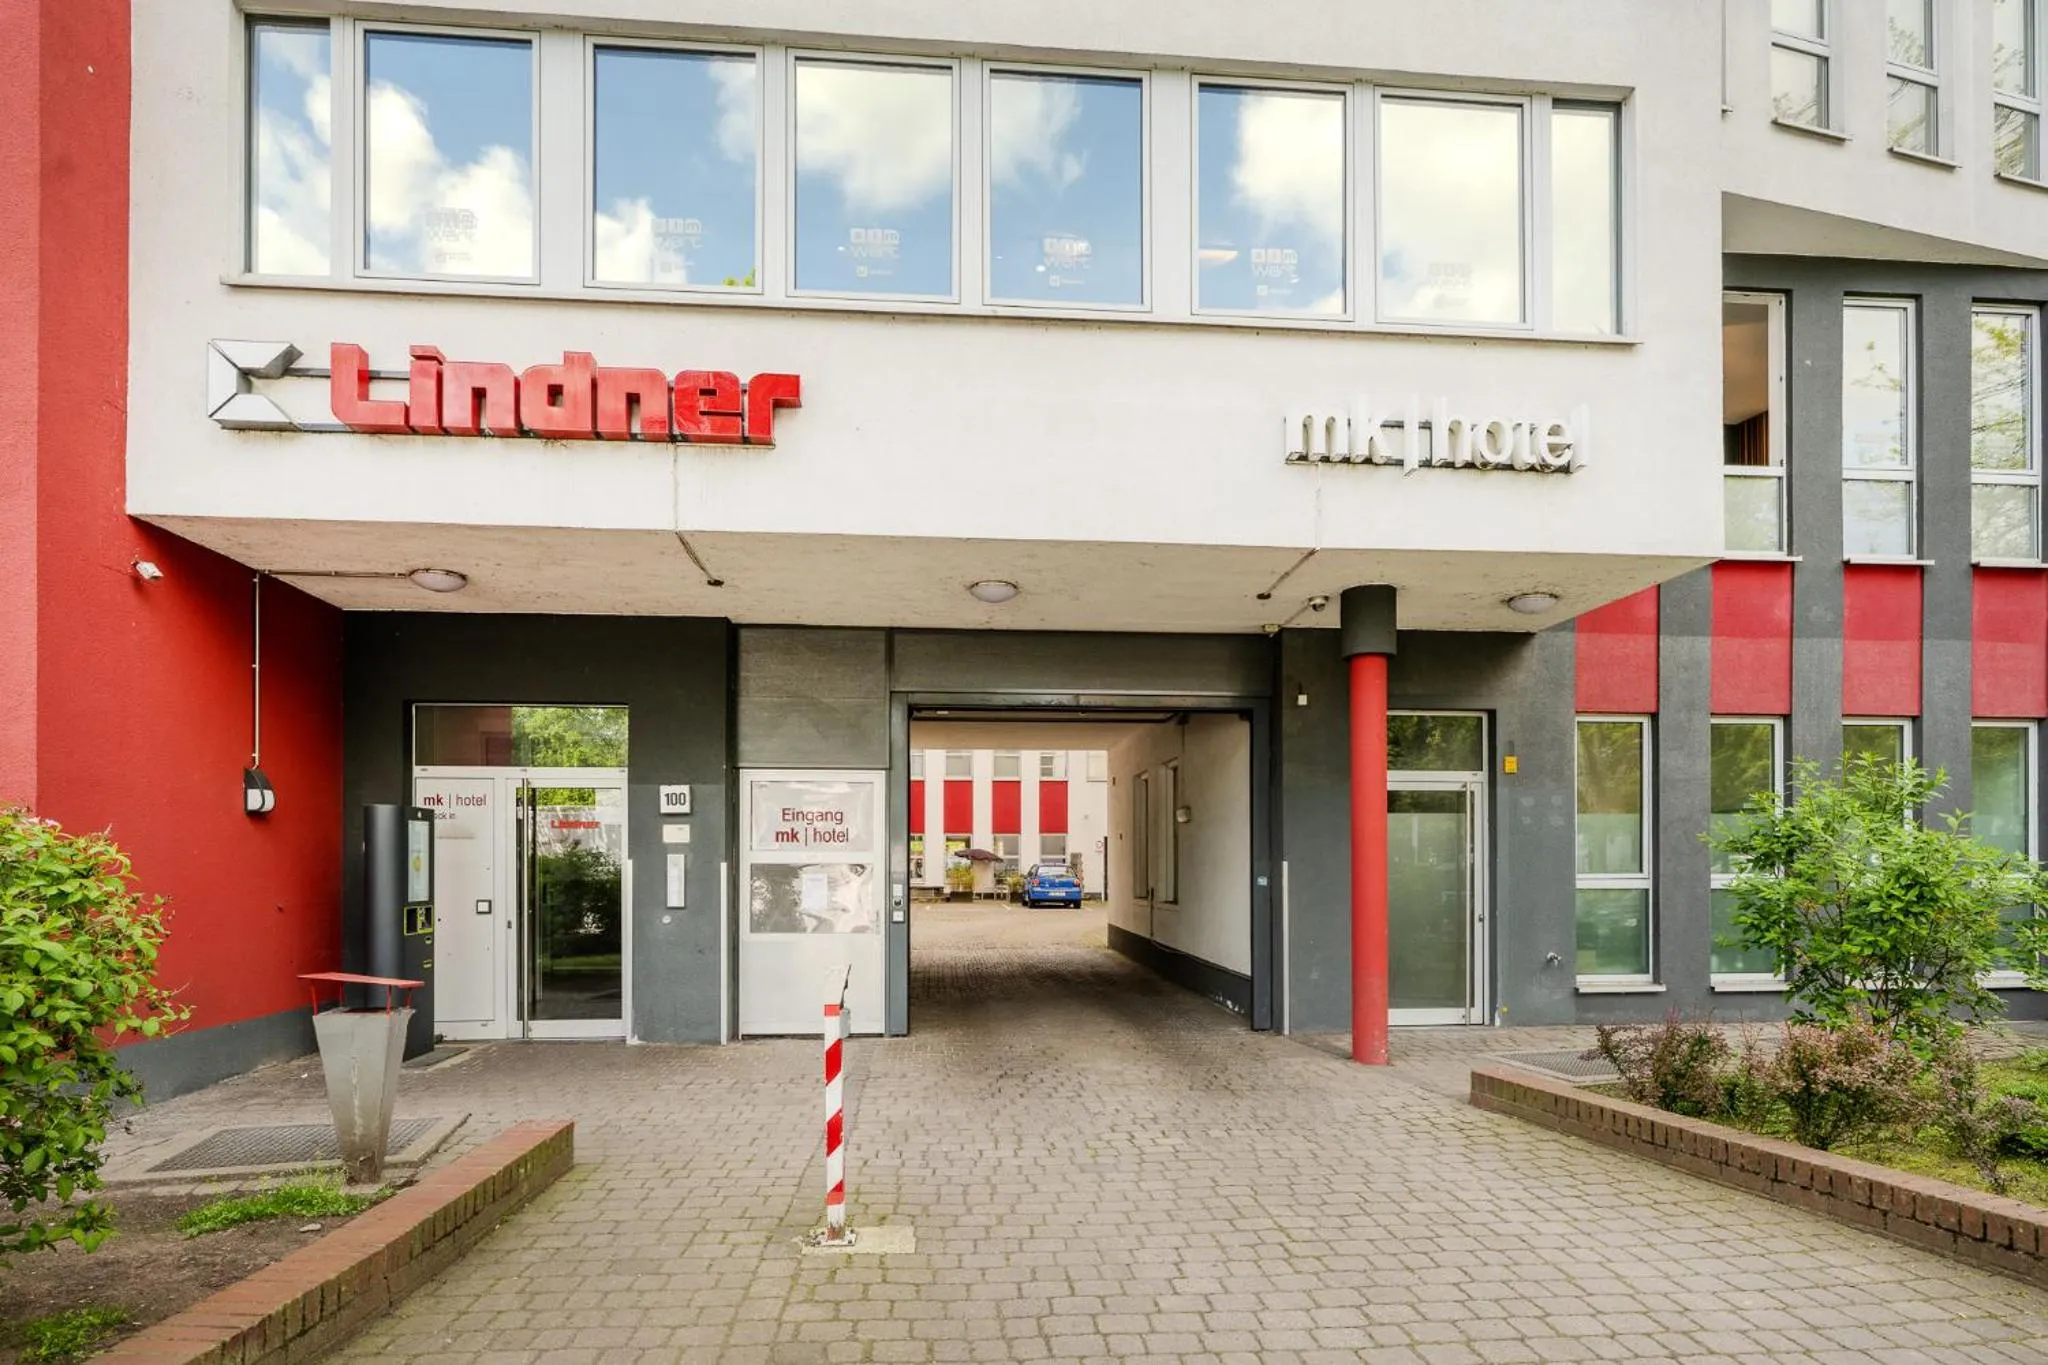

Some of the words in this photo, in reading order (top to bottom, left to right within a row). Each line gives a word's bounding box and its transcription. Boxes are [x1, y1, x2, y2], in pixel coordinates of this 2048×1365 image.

[331, 342, 801, 447] Lindner
[1284, 392, 1393, 465] mk
[1431, 394, 1590, 475] hotel
[423, 793, 444, 807] mk
[455, 793, 487, 807] hotel
[664, 792, 687, 807] 100
[781, 807, 844, 826] Eingang
[775, 827, 800, 843] mk
[813, 827, 849, 843] hotel
